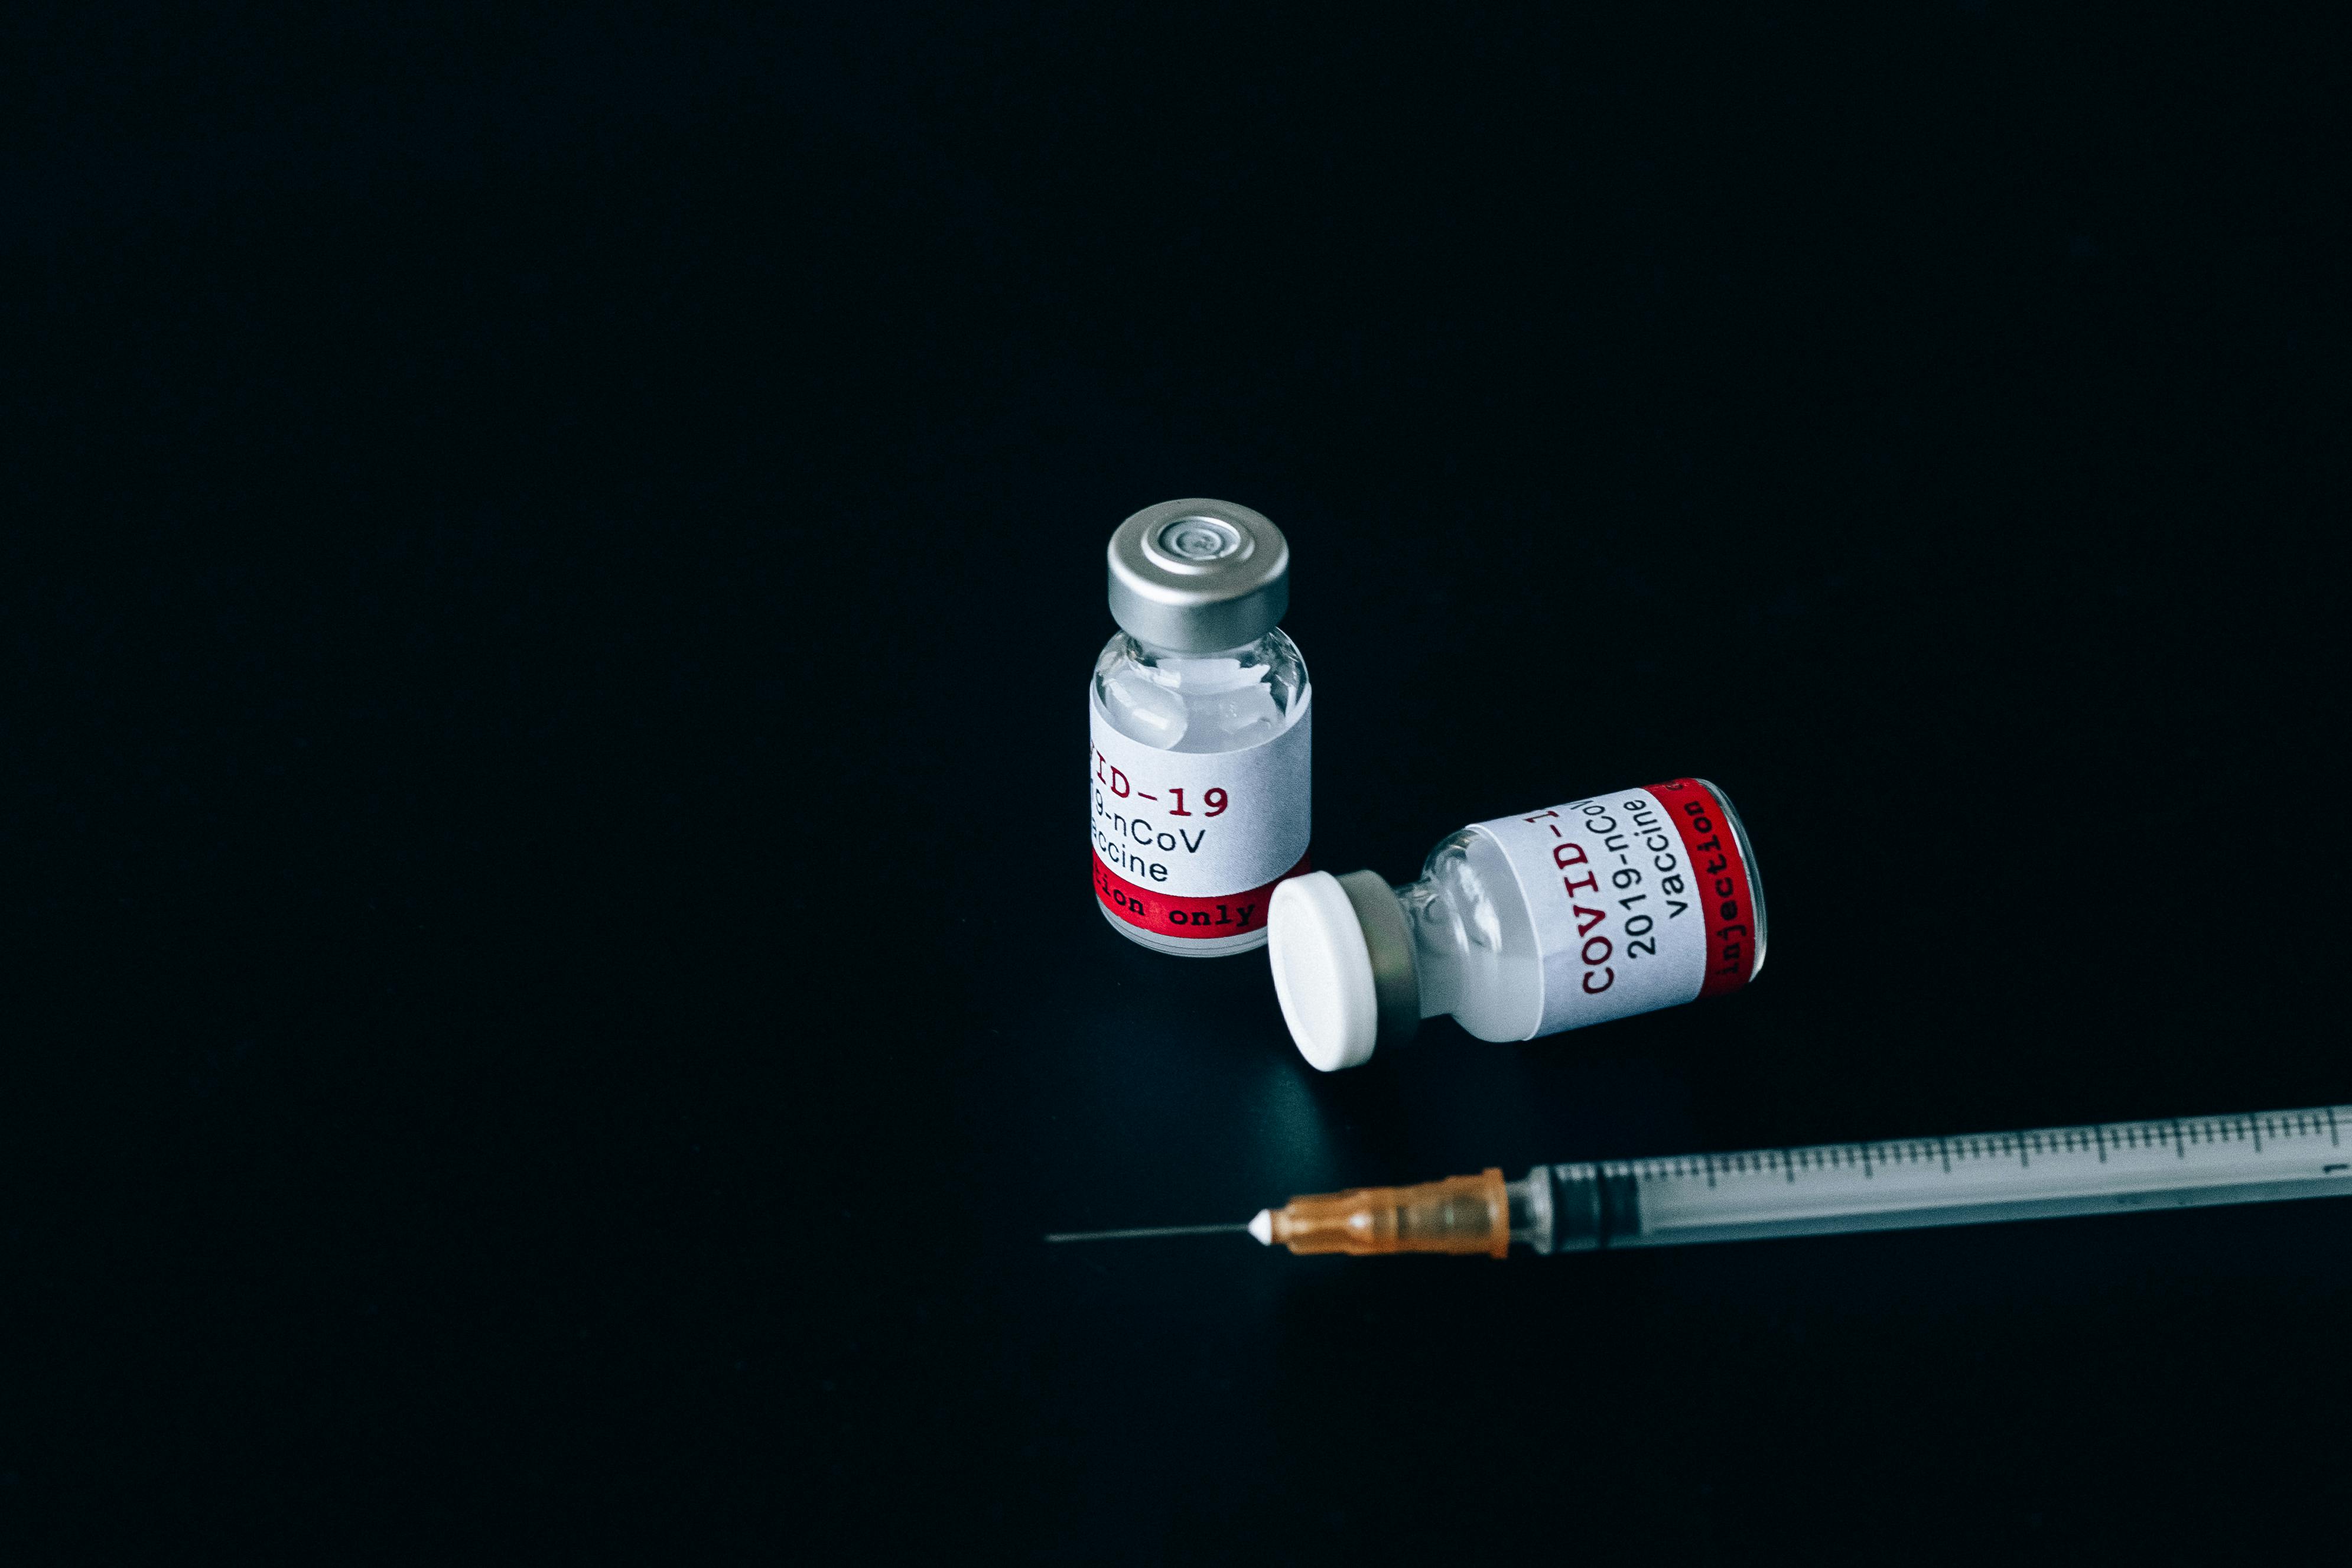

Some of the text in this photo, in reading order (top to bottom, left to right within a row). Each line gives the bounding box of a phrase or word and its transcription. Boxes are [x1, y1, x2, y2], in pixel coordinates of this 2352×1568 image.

[1169, 904, 1256, 927] only
[1565, 800, 1656, 959] 2019-nCoV
[1623, 799, 1689, 919] vaccine
[1684, 801, 1746, 975] injection
